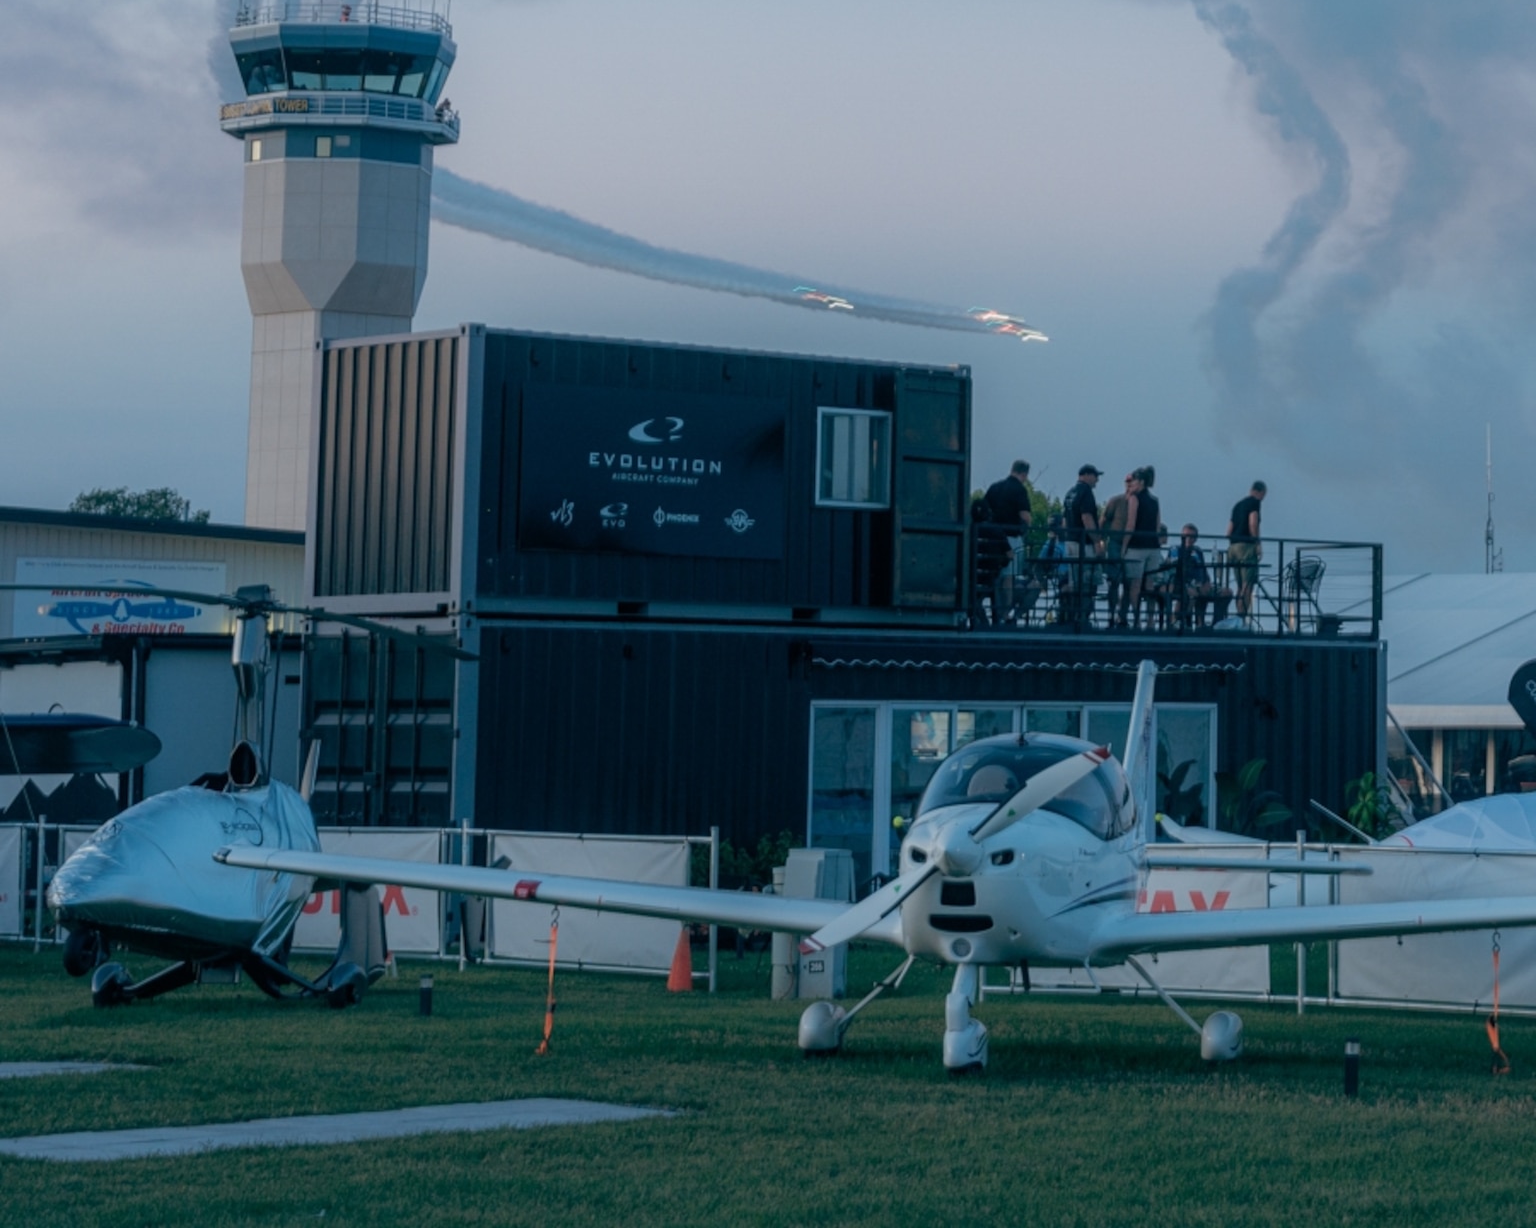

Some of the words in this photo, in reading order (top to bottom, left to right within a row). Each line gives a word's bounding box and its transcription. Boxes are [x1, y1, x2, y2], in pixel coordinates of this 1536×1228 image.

[275, 99, 309, 113] TOWER
[589, 452, 722, 475] EVOLUTION
[611, 473, 653, 484] AIRCRAFT
[656, 475, 698, 486] COMPANY
[602, 519, 626, 528] EVO
[666, 513, 700, 524] PHOENIX
[104, 621, 166, 635] Specialty
